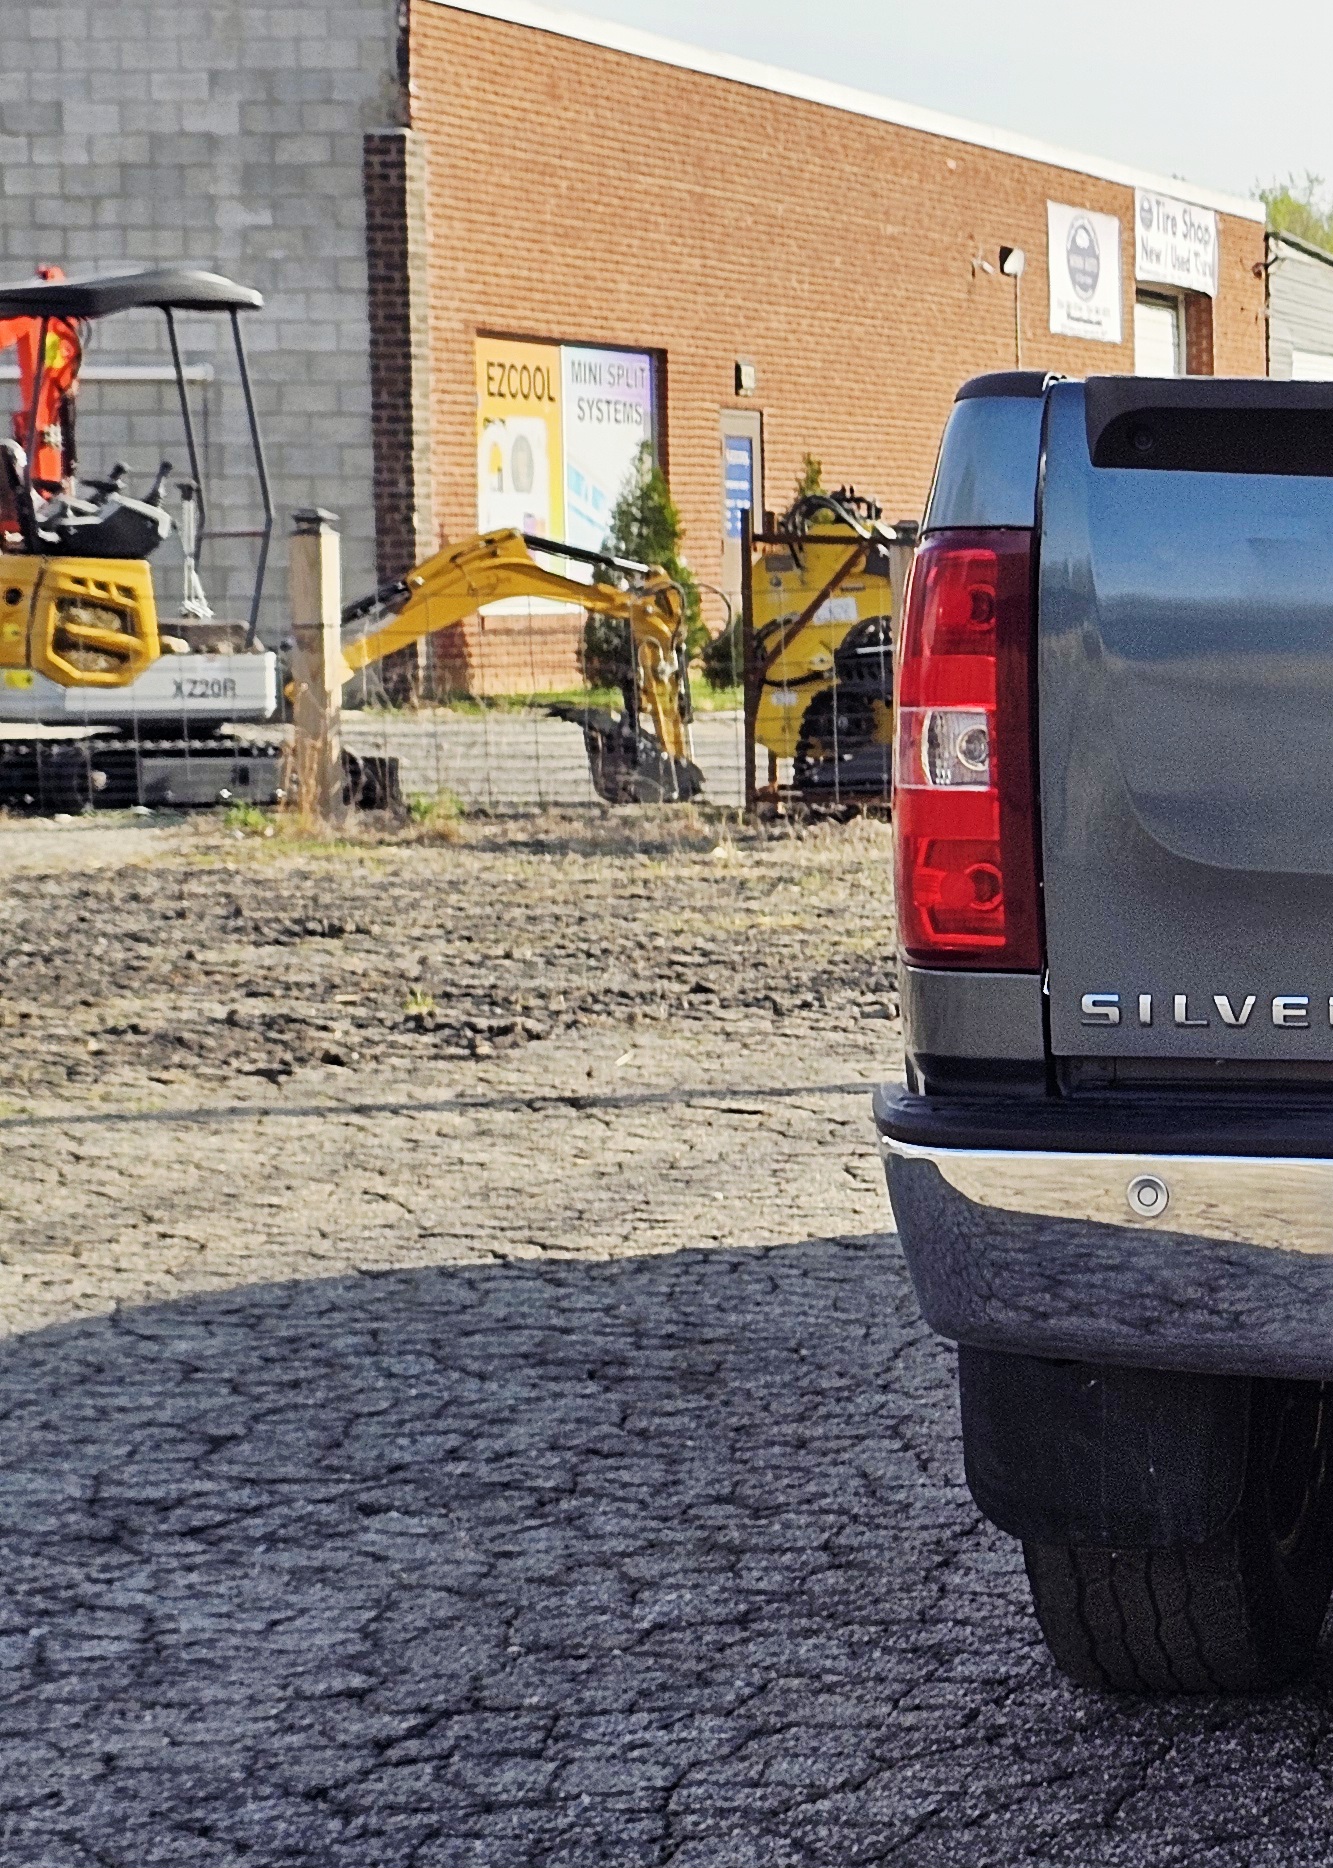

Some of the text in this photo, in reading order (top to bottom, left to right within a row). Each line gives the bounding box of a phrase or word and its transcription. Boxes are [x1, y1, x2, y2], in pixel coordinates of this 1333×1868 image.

[1156, 198, 1211, 254] Tire Shop
[1140, 235, 1161, 265] New
[1170, 243, 1190, 274] Used
[486, 360, 556, 402] EZCOOL
[571, 359, 646, 390] MINI SPLIT
[577, 396, 643, 426] SYSTEMS
